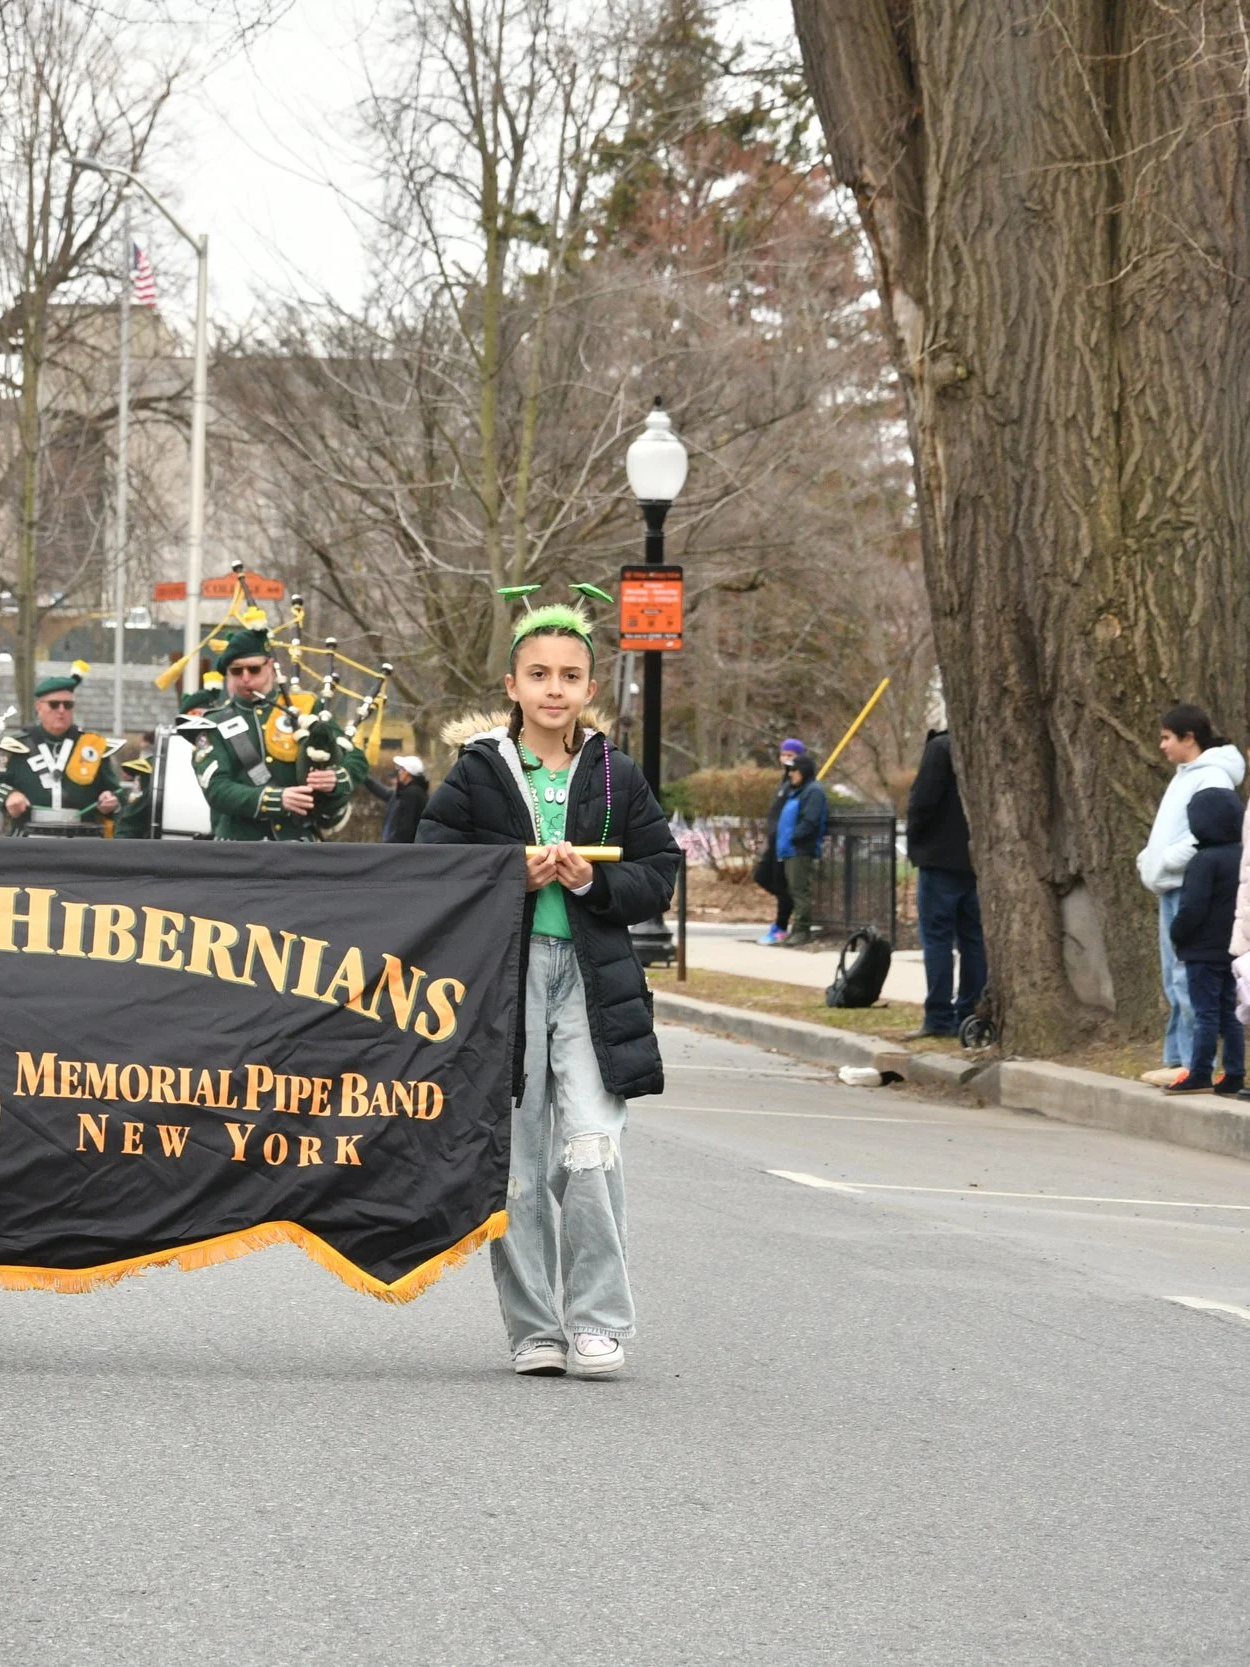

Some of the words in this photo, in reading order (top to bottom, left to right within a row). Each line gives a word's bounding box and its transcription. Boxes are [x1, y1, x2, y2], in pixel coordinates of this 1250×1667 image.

[13, 1050, 239, 1111] MEMORIAL
[243, 1063, 333, 1118] PIPE
[337, 1072, 445, 1122] BAND
[76, 1112, 192, 1158] NEW
[223, 1121, 366, 1168] YORK
